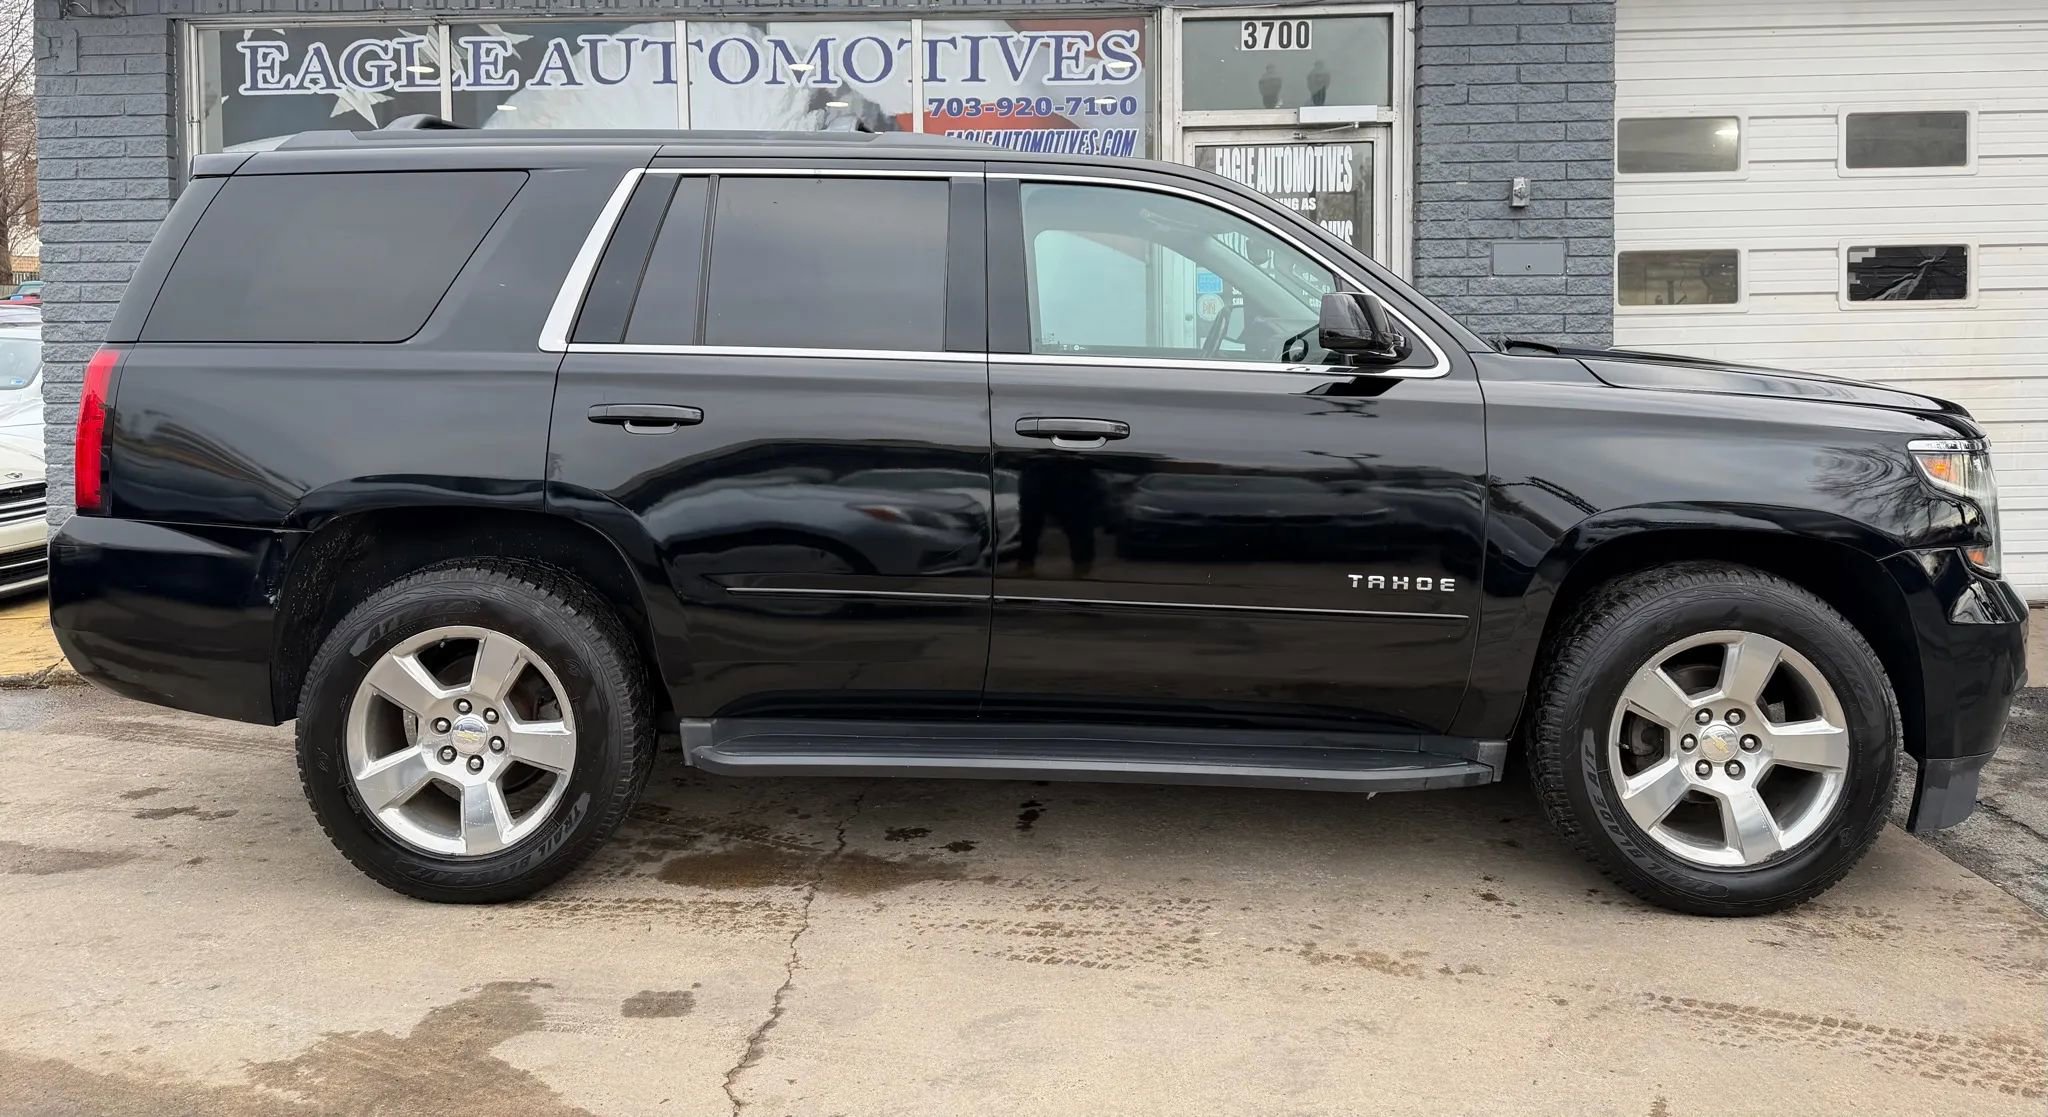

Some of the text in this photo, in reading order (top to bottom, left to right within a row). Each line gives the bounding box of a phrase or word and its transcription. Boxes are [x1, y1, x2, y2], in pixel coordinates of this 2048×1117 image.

[1243, 20, 1310, 49] 3700
[237, 29, 1141, 94] EAGLE AUTOMOTIVES
[928, 96, 1138, 118] 703-920-7100
[1215, 145, 1353, 194] EAGLE AUTOMOTIVES
[1301, 197, 1317, 211] AS
[1347, 574, 1456, 592] TAHOE
